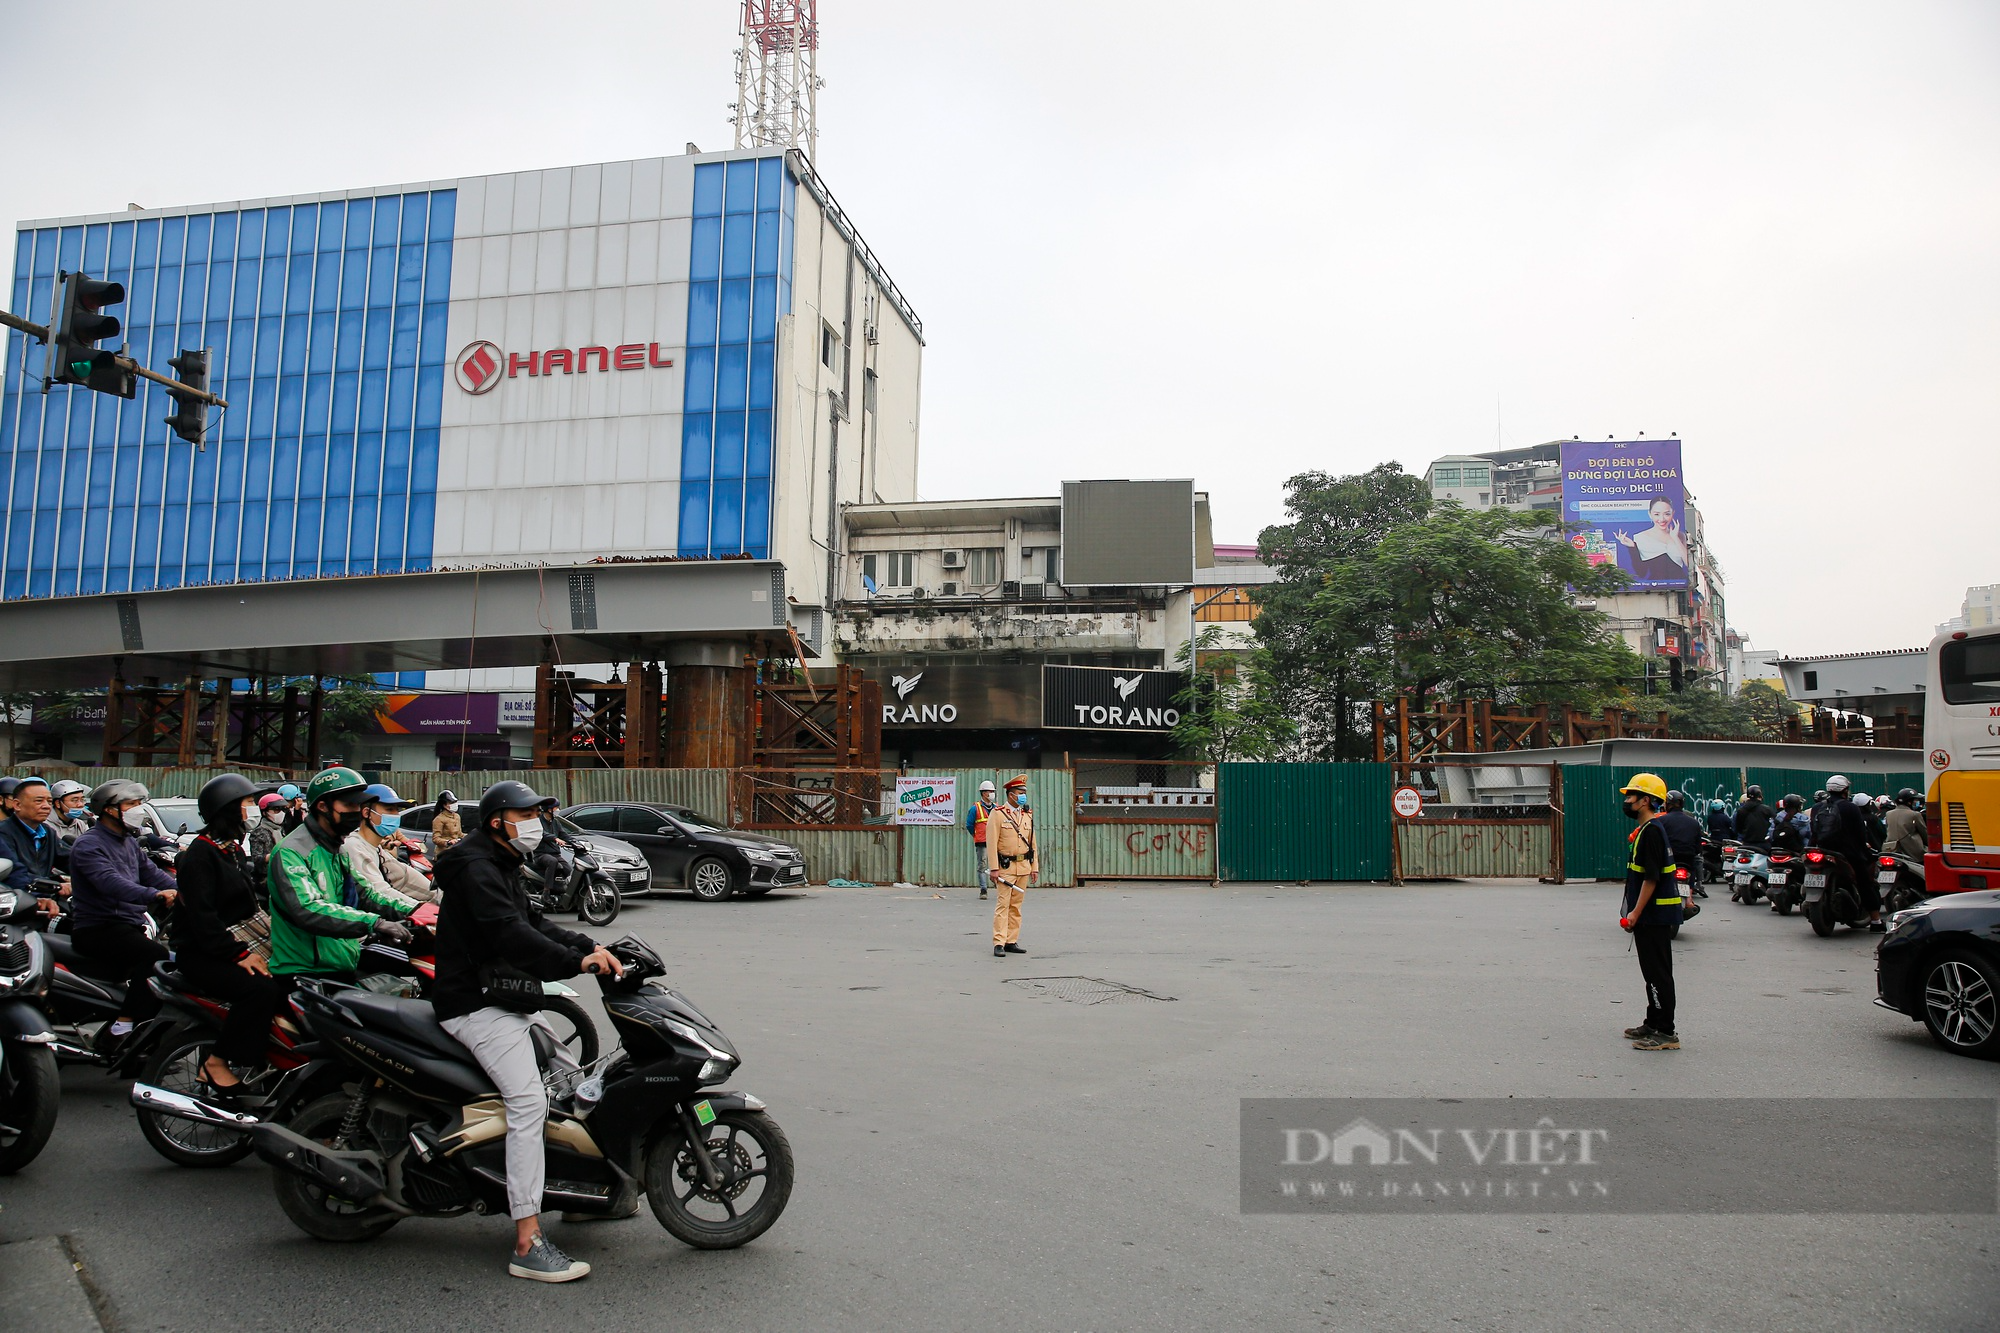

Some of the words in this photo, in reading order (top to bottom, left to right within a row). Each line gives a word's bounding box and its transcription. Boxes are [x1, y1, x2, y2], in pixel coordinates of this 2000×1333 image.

[508, 342, 673, 378] HANEL
[1588, 458, 1610, 470] ĐỢI
[1612, 456, 1635, 467] ĐÈN
[1637, 455, 1655, 467] ĐỎ
[1568, 469, 1602, 480] ĐỪNG
[1604, 469, 1625, 481] ĐỢI
[1627, 468, 1650, 479] LÃO
[1652, 467, 1677, 478] HOÁ
[1580, 484, 1600, 494] Săn
[1602, 486, 1627, 495] ngay
[1630, 484, 1653, 493] DHC
[1655, 483, 1664, 492] !!!
[882, 703, 957, 724] RANO
[1074, 703, 1180, 727] TORANO
[314, 772, 340, 786] Grab
[917, 789, 930, 799] web
